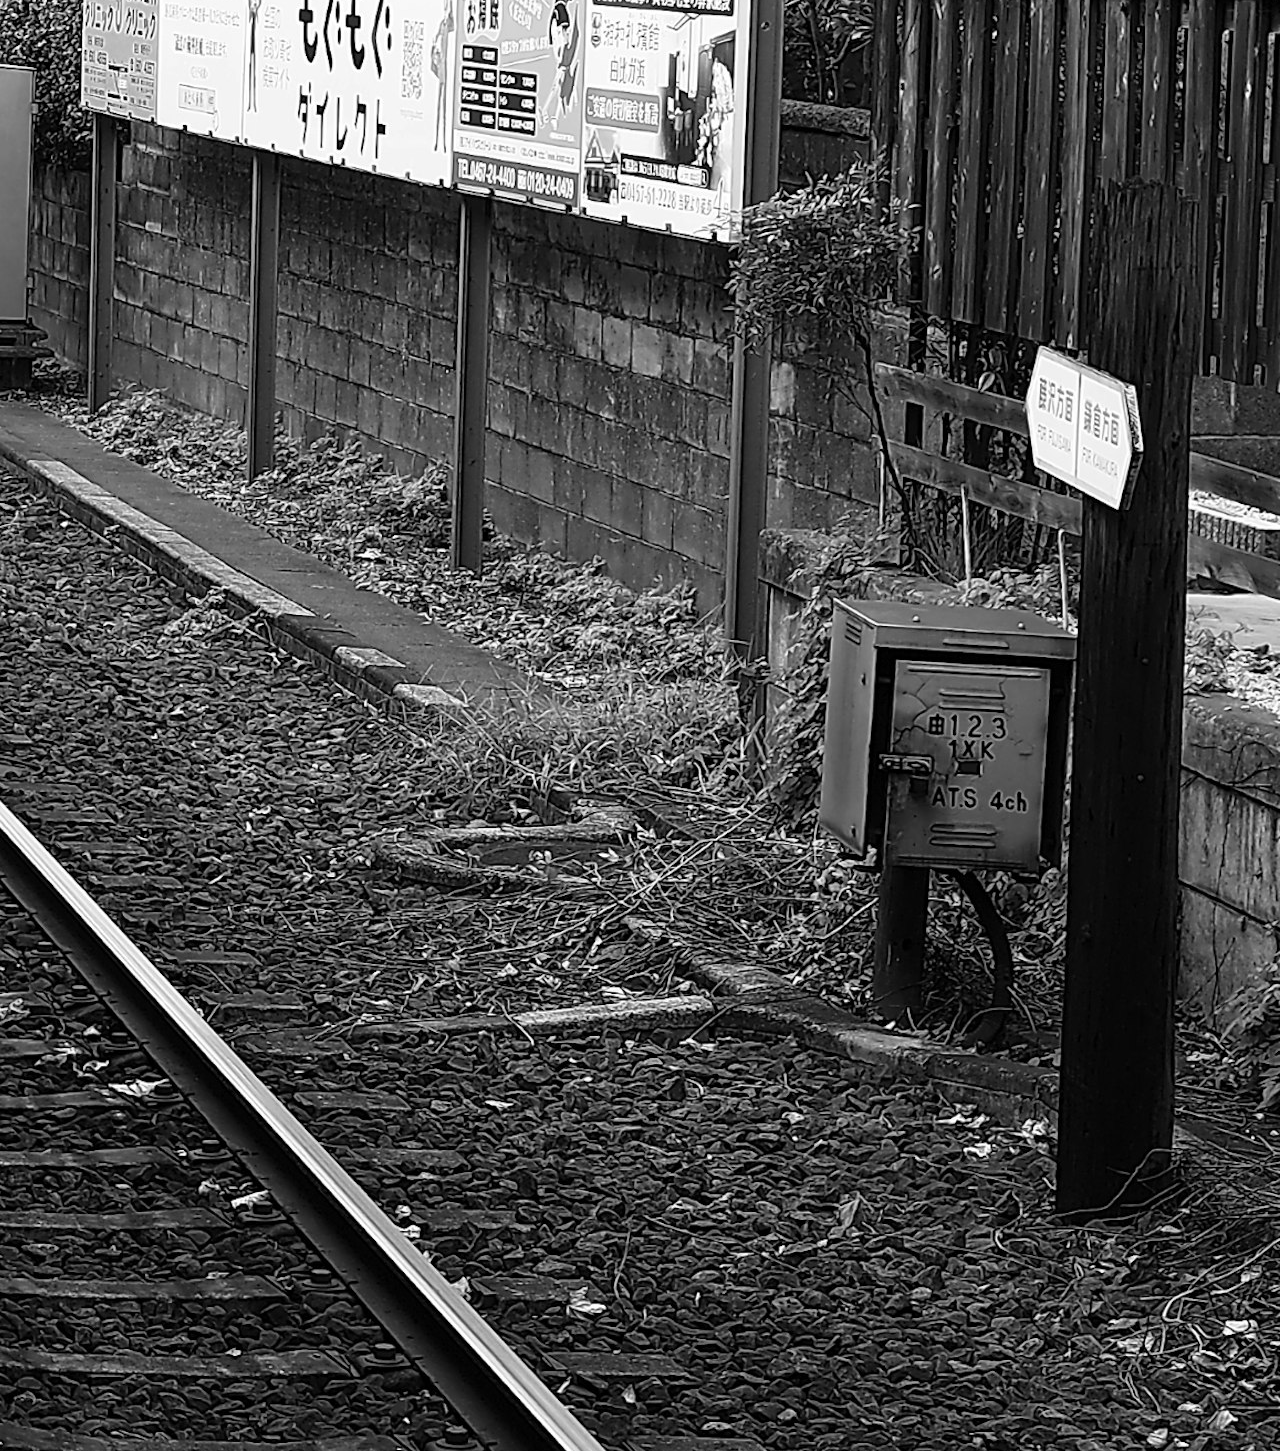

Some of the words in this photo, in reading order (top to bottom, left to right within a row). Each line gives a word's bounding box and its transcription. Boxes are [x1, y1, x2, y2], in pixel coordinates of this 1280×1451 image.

[84, 2, 115, 32] クリニック
[125, 7, 157, 40] クリニック
[297, 81, 387, 159] ダイレクト
[1038, 376, 1074, 423] 藤沢方面
[1083, 399, 1121, 447] 鎌倉方面
[989, 791, 1028, 812] 4ch
